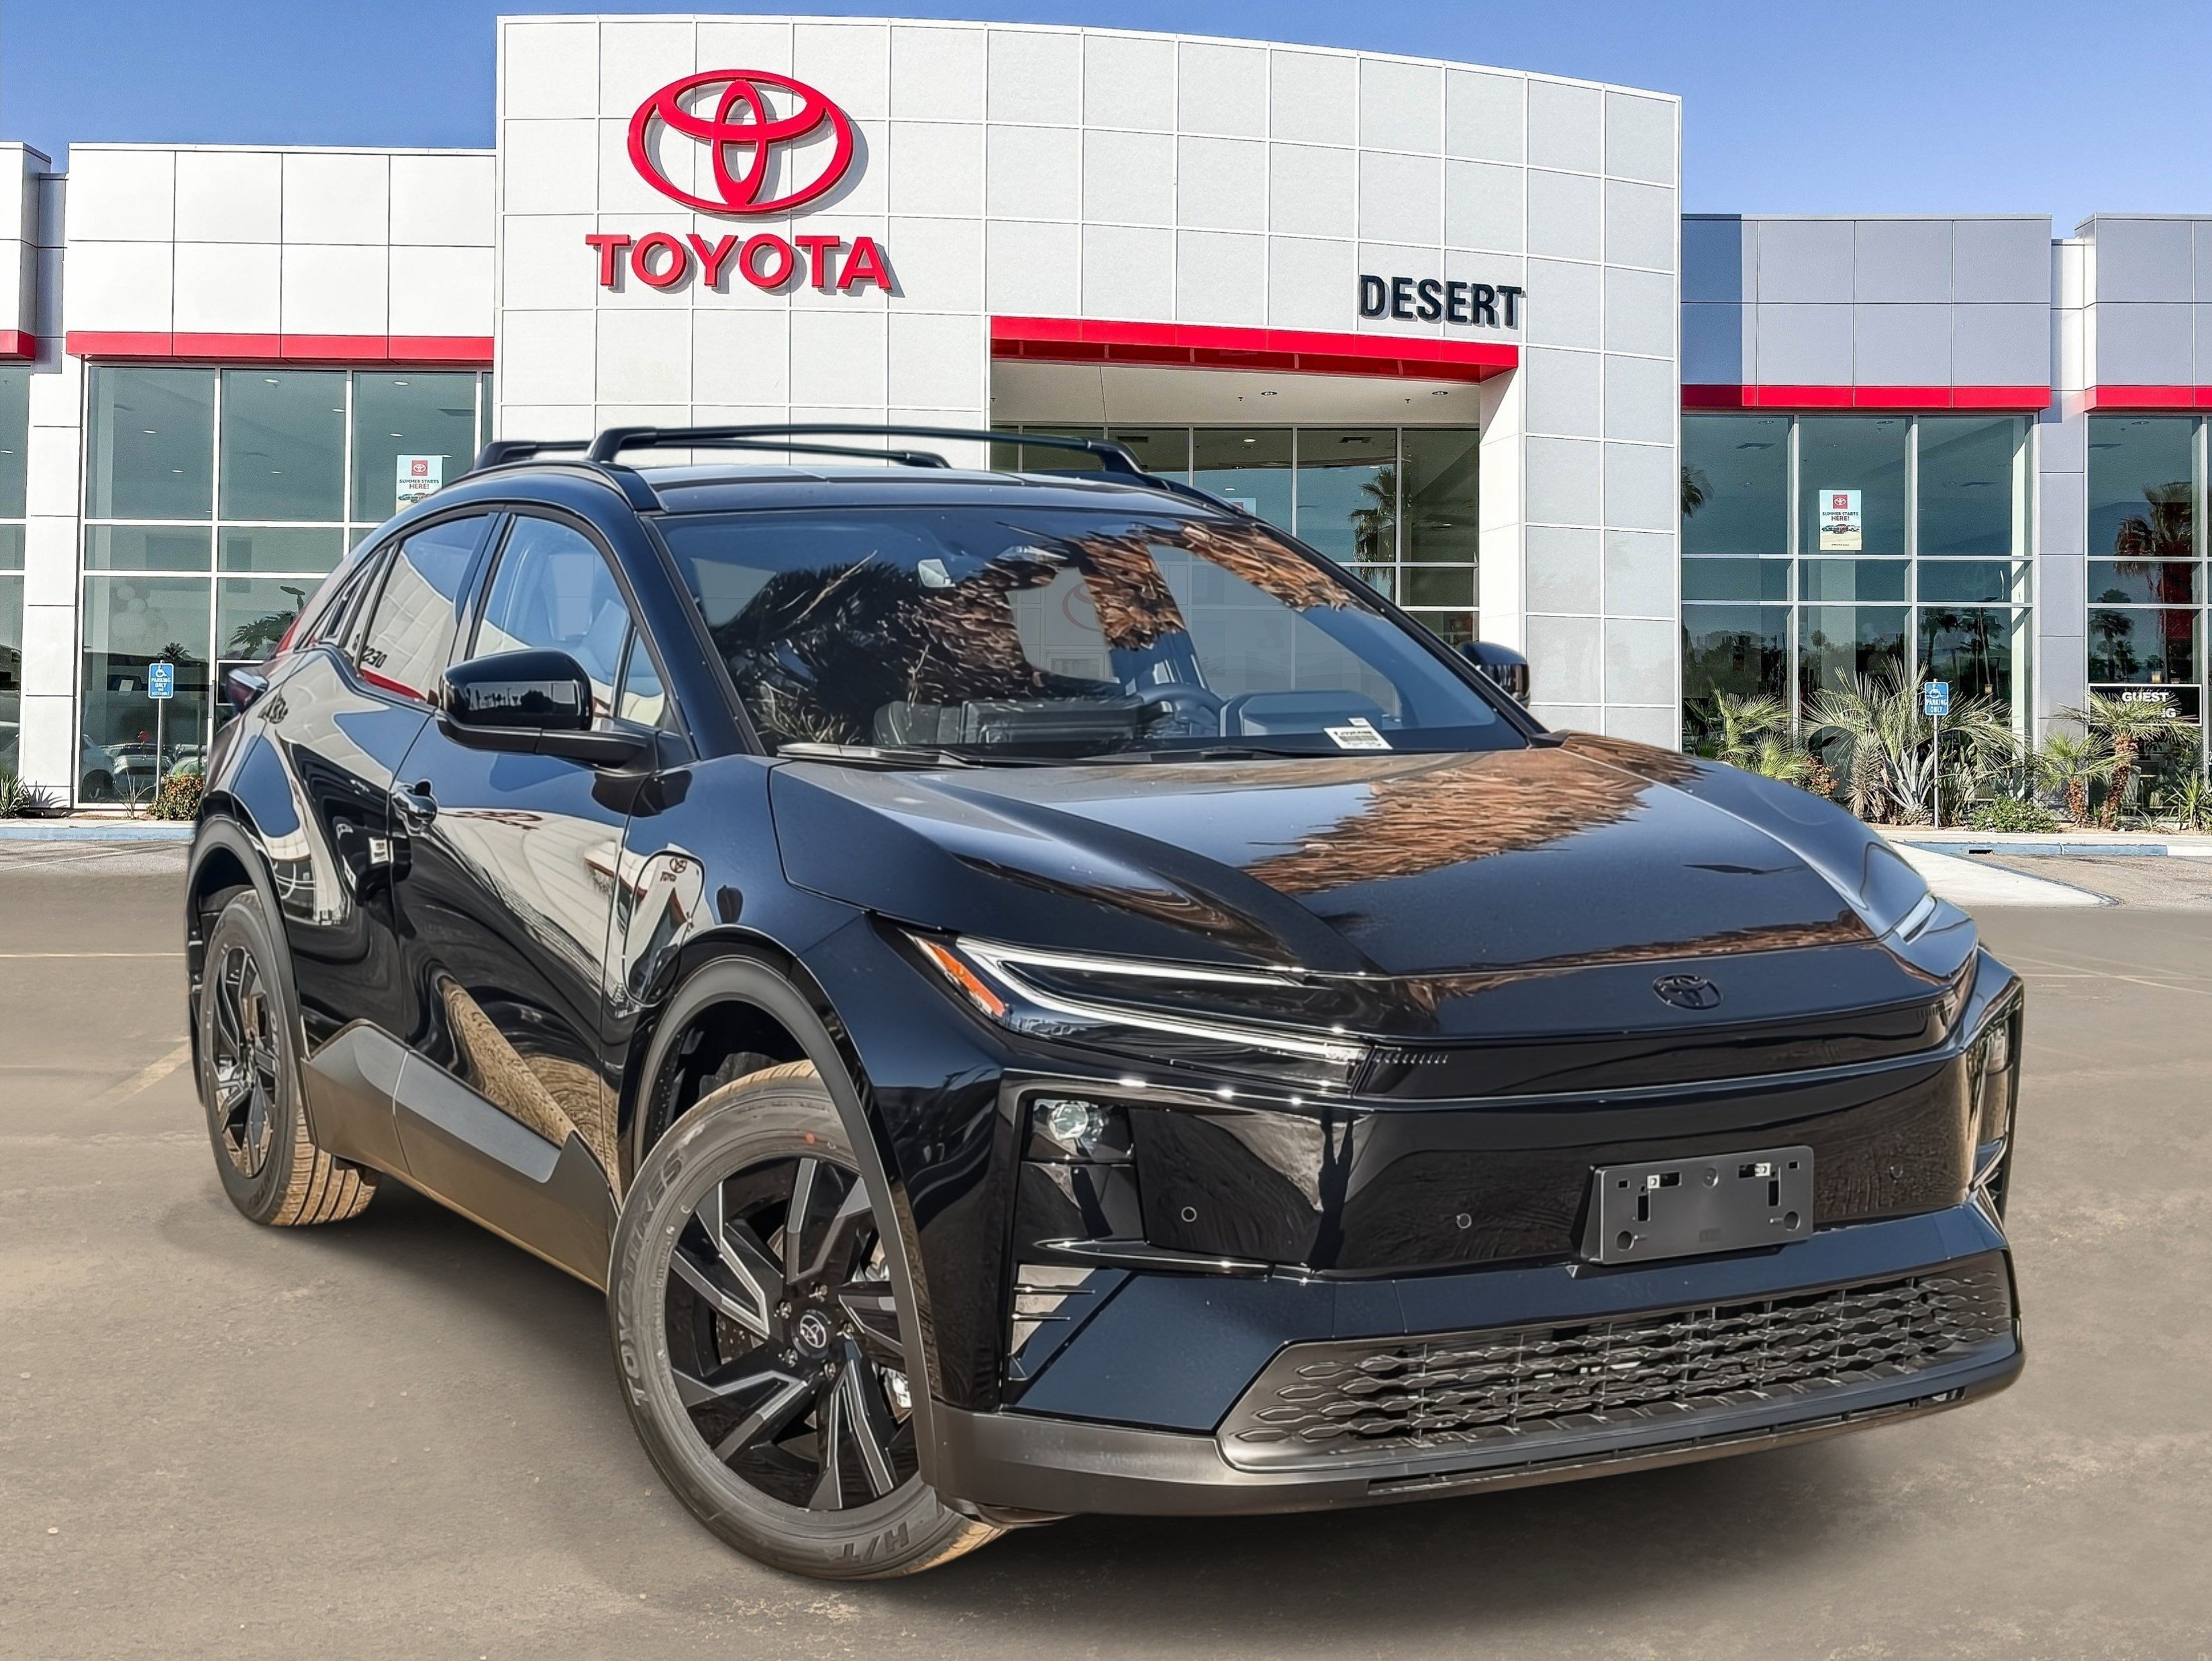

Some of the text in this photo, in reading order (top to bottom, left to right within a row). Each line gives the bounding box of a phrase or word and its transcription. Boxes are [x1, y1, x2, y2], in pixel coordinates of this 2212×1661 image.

[586, 232, 893, 291] TOYOTA
[1359, 274, 1523, 328] DESERT
[1930, 705, 1944, 713] ONLY
[2121, 691, 2170, 703] GUEST
